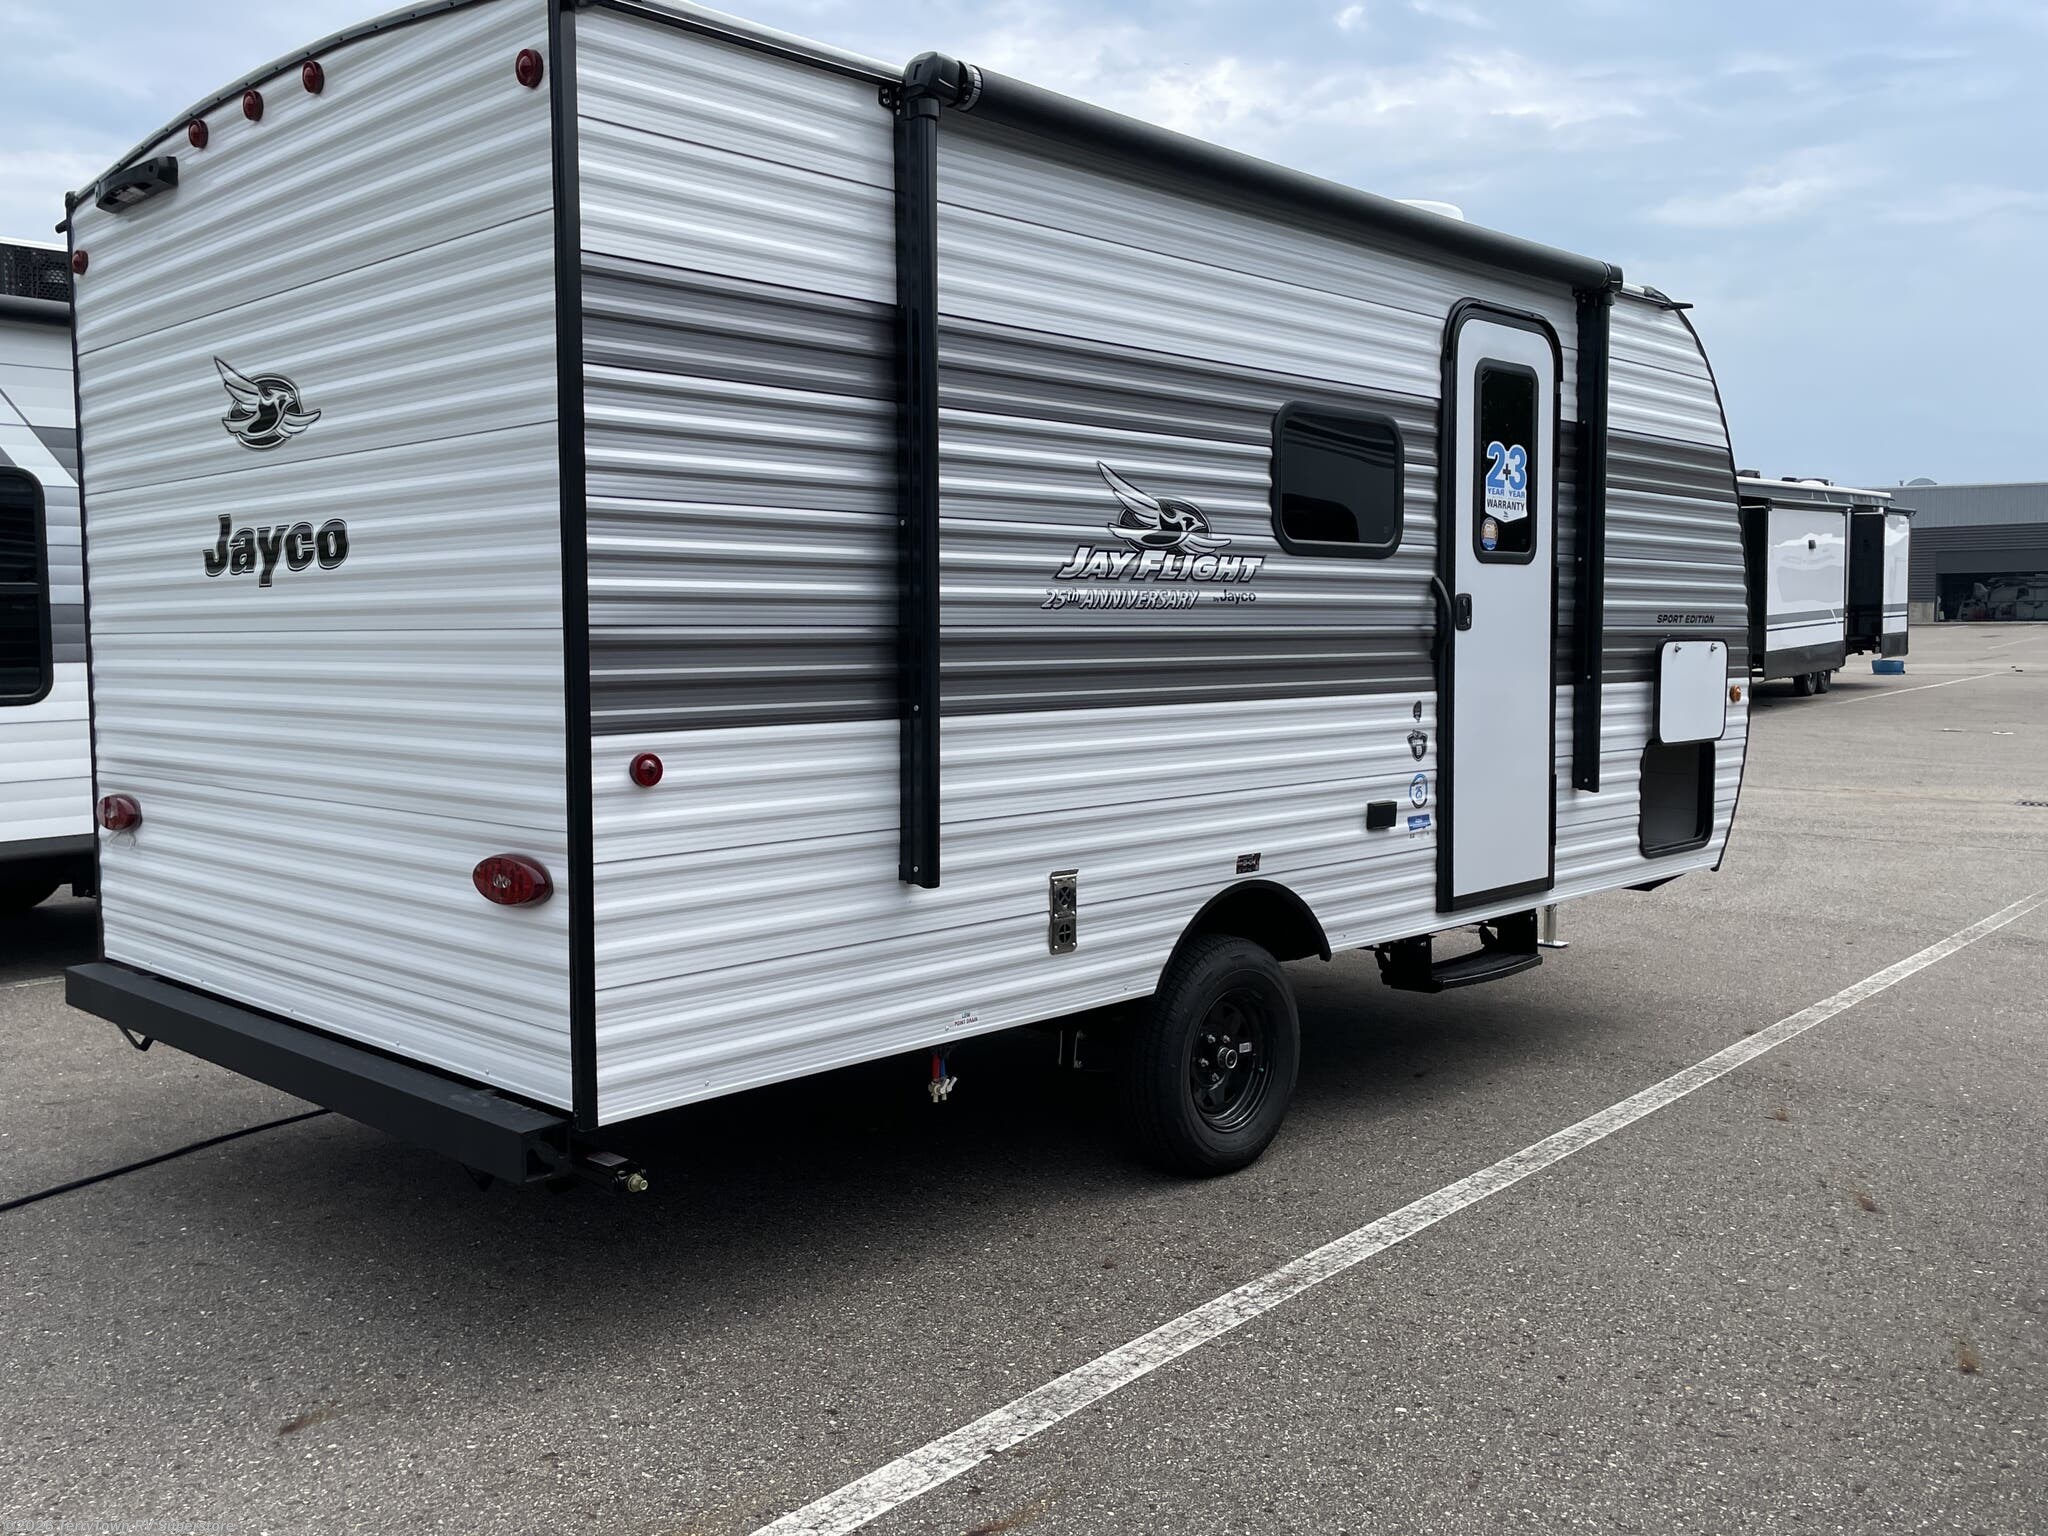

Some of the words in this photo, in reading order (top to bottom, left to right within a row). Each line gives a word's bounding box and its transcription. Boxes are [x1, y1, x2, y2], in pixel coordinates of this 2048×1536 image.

[1487, 487, 1505, 496] YEAR
[1508, 490, 1525, 499] YEAR
[1486, 499, 1525, 511] WARRANTY
[202, 513, 349, 588] Jayco
[1053, 544, 1137, 581] JAY
[1130, 548, 1267, 584] FLIGHT
[1040, 588, 1080, 609] 25th
[1079, 589, 1200, 610] ANNIVERSARY
[1220, 589, 1256, 604] Jayco
[1656, 614, 1684, 624] SPORT
[1685, 615, 1715, 624] EDITION
